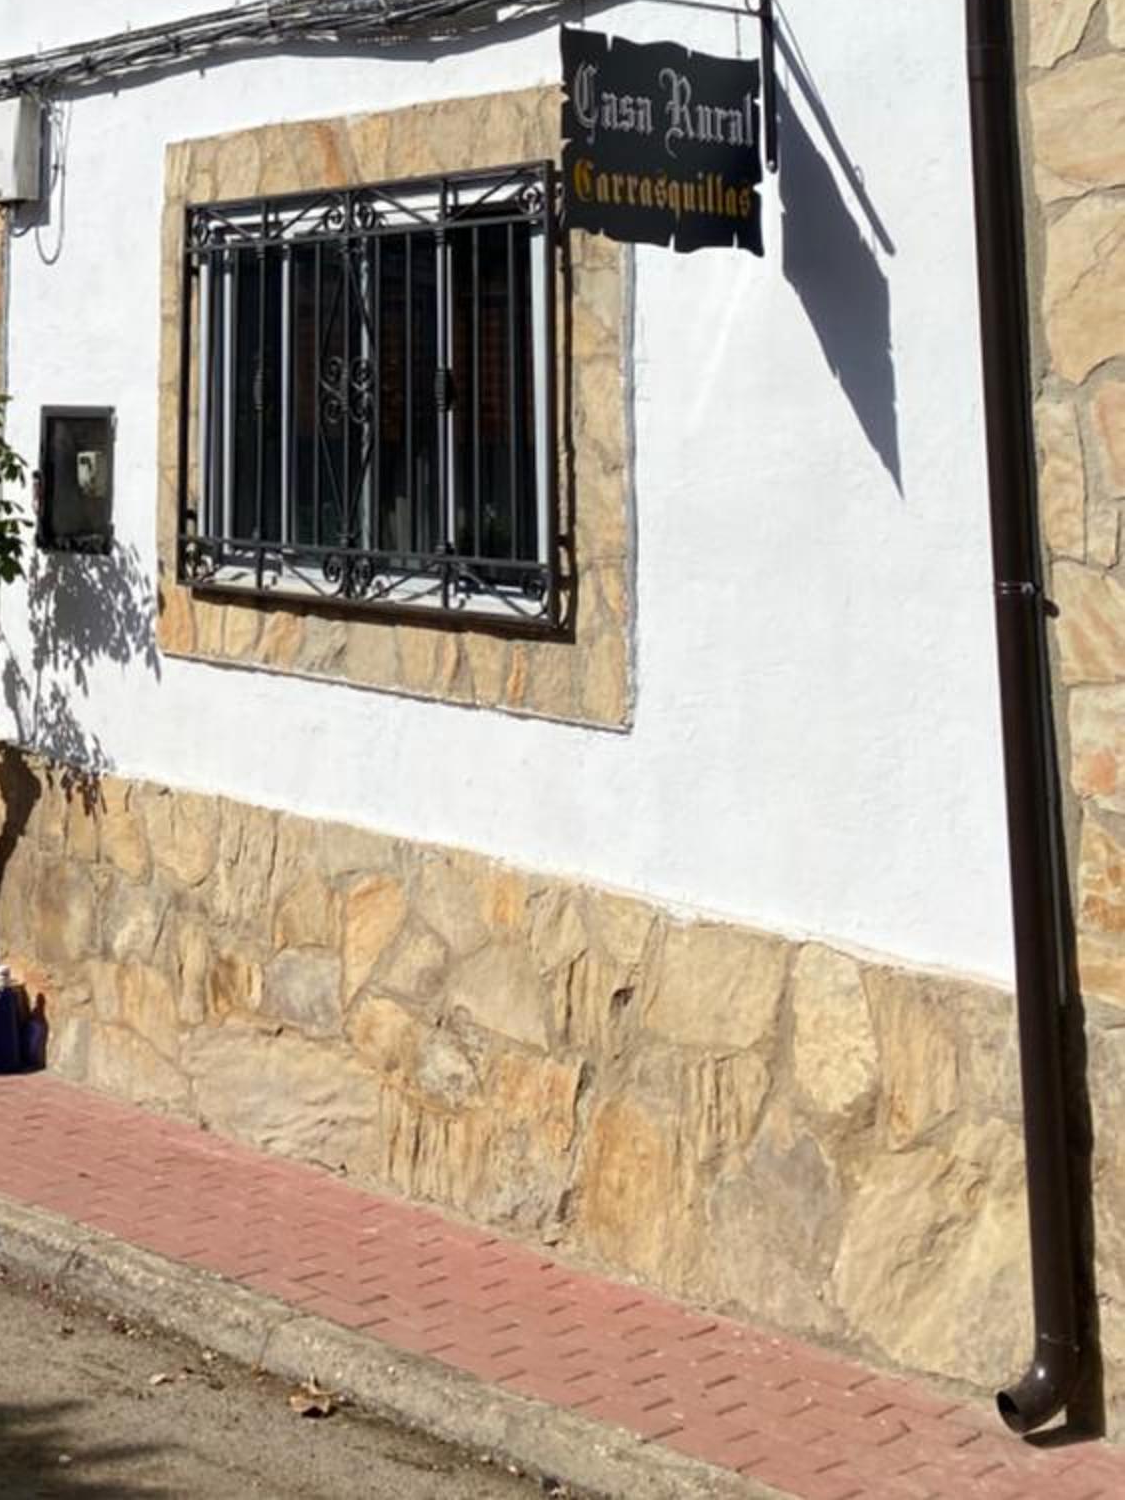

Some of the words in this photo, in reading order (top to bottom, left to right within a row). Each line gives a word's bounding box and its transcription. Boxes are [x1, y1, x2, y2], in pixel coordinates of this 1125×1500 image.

[574, 63, 652, 146] Casa
[659, 67, 754, 158] Rural
[574, 158, 751, 219] Carrasquillas
